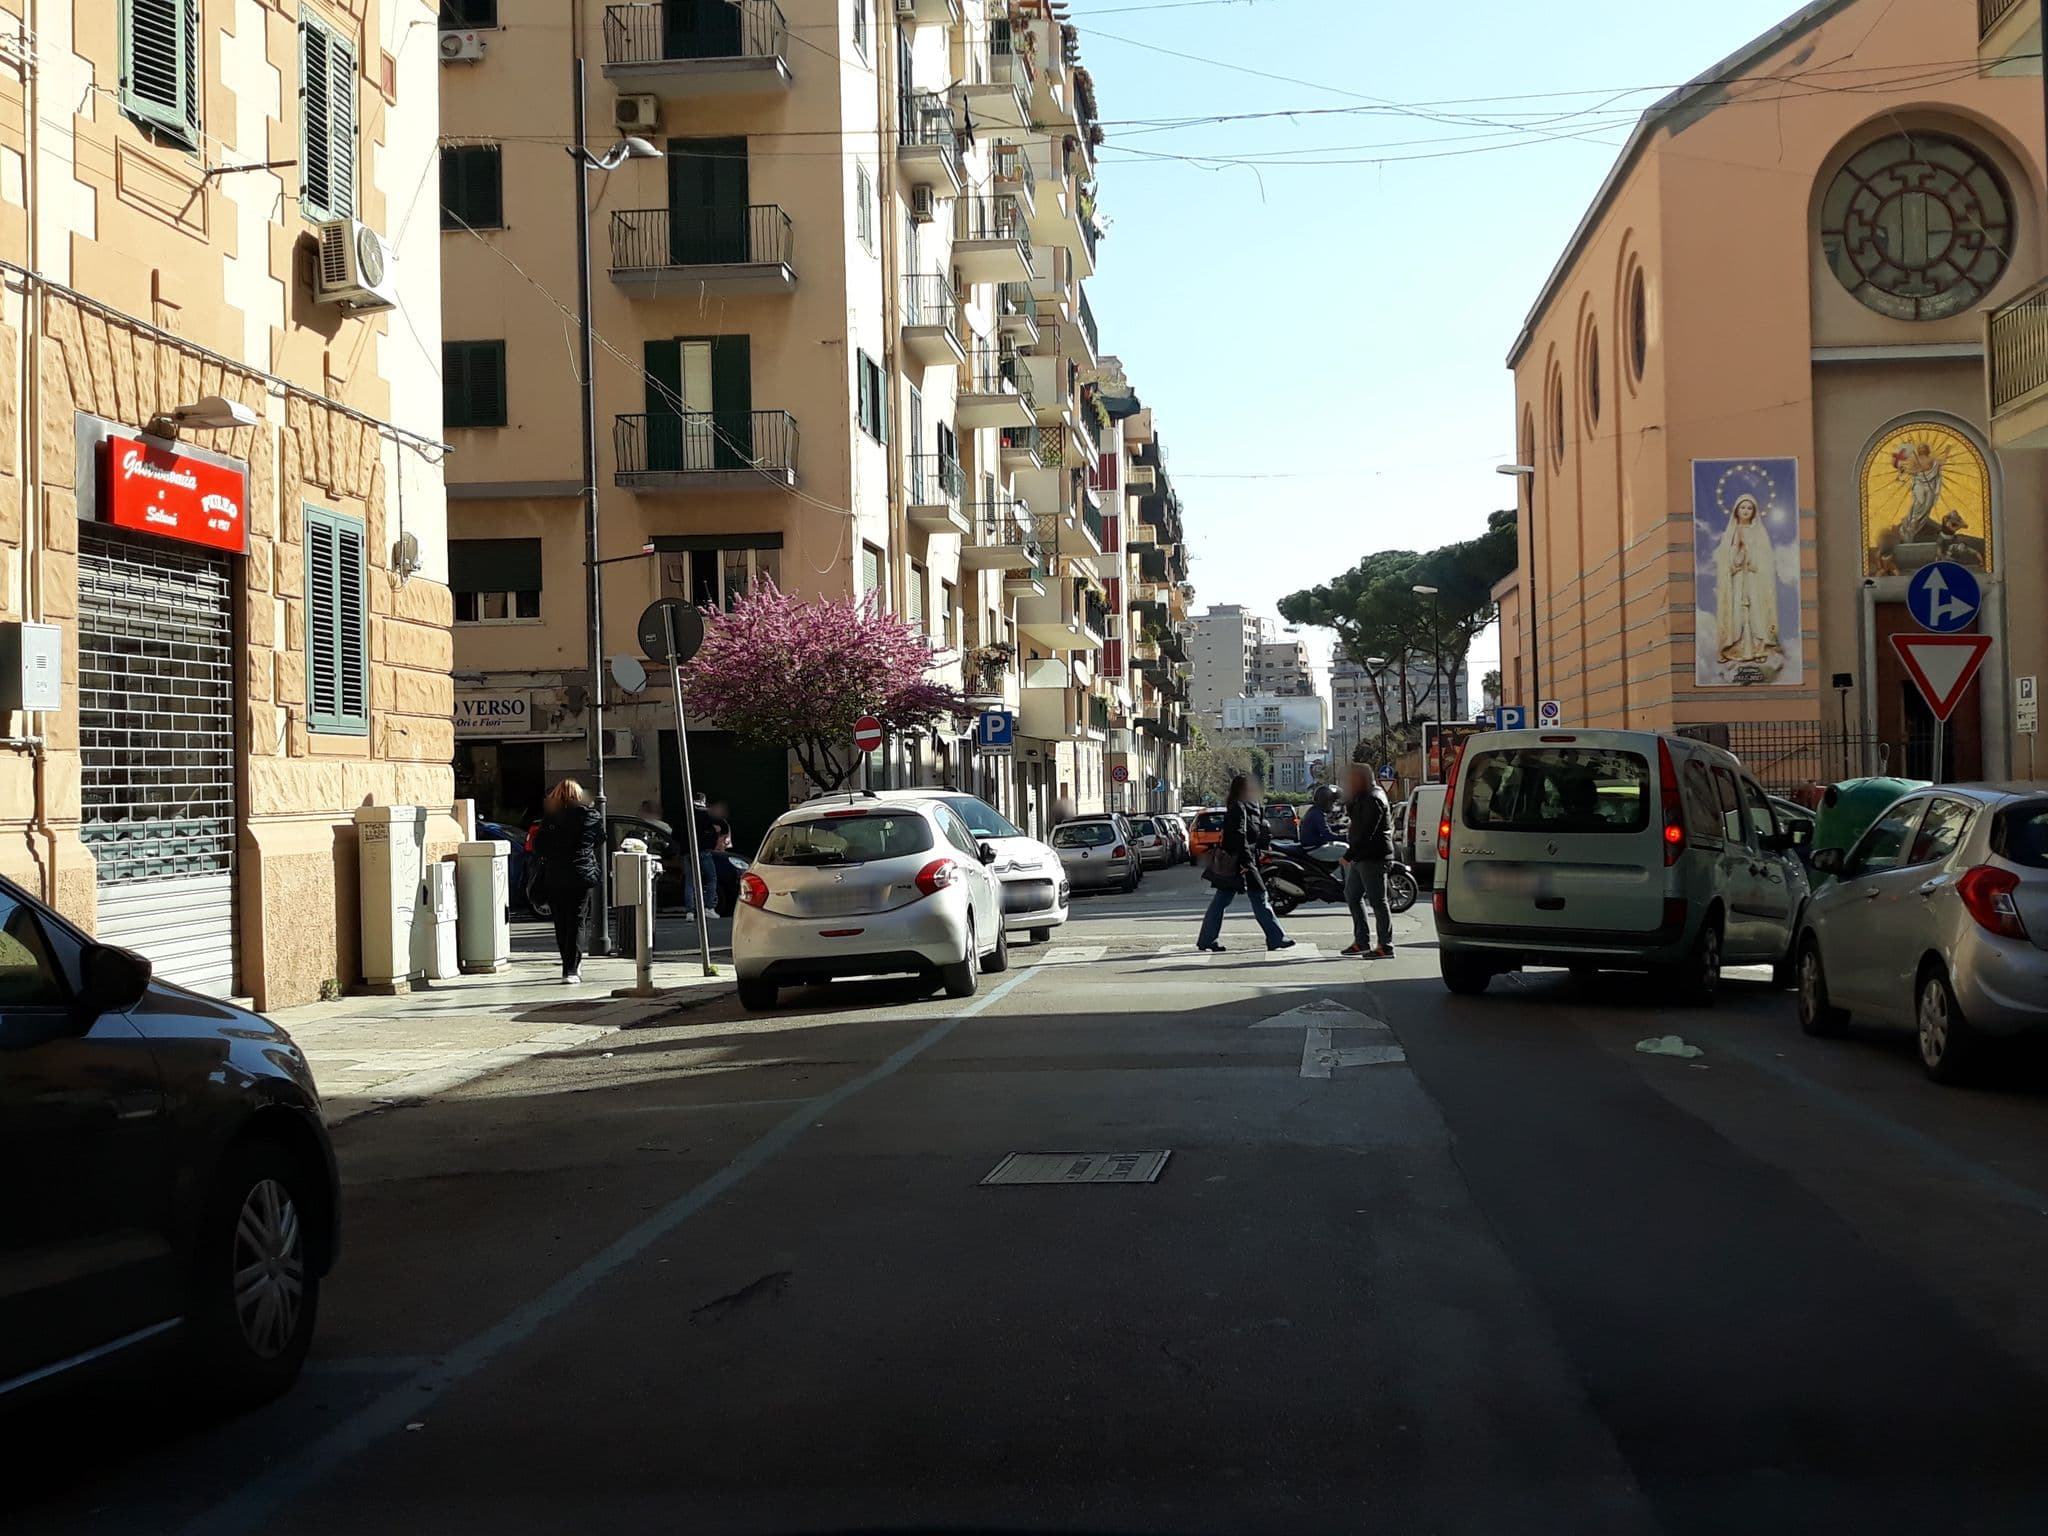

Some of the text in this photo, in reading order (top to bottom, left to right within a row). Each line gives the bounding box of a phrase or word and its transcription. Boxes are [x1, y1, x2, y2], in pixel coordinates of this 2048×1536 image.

[462, 699, 525, 715] VERSO
[480, 717, 502, 727] Fiori
[987, 715, 1005, 741] P
[1502, 709, 1520, 730] P
